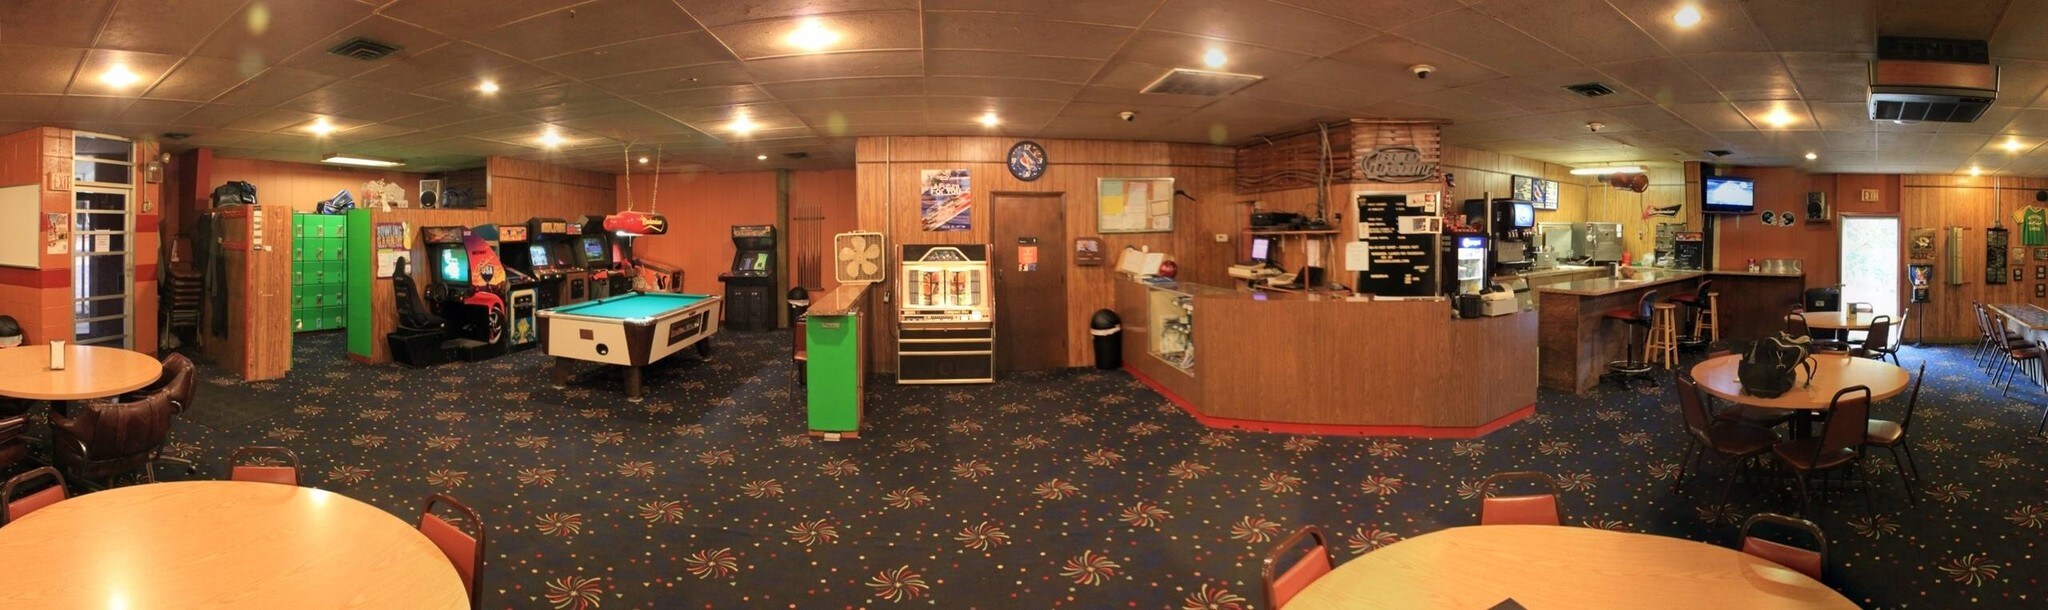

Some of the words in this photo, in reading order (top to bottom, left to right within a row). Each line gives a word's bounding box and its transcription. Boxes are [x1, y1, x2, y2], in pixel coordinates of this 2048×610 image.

[54, 174, 70, 190] EXIT
[946, 187, 961, 195] YOU
[1862, 189, 1879, 202] EXIT
[481, 266, 493, 275] USA
